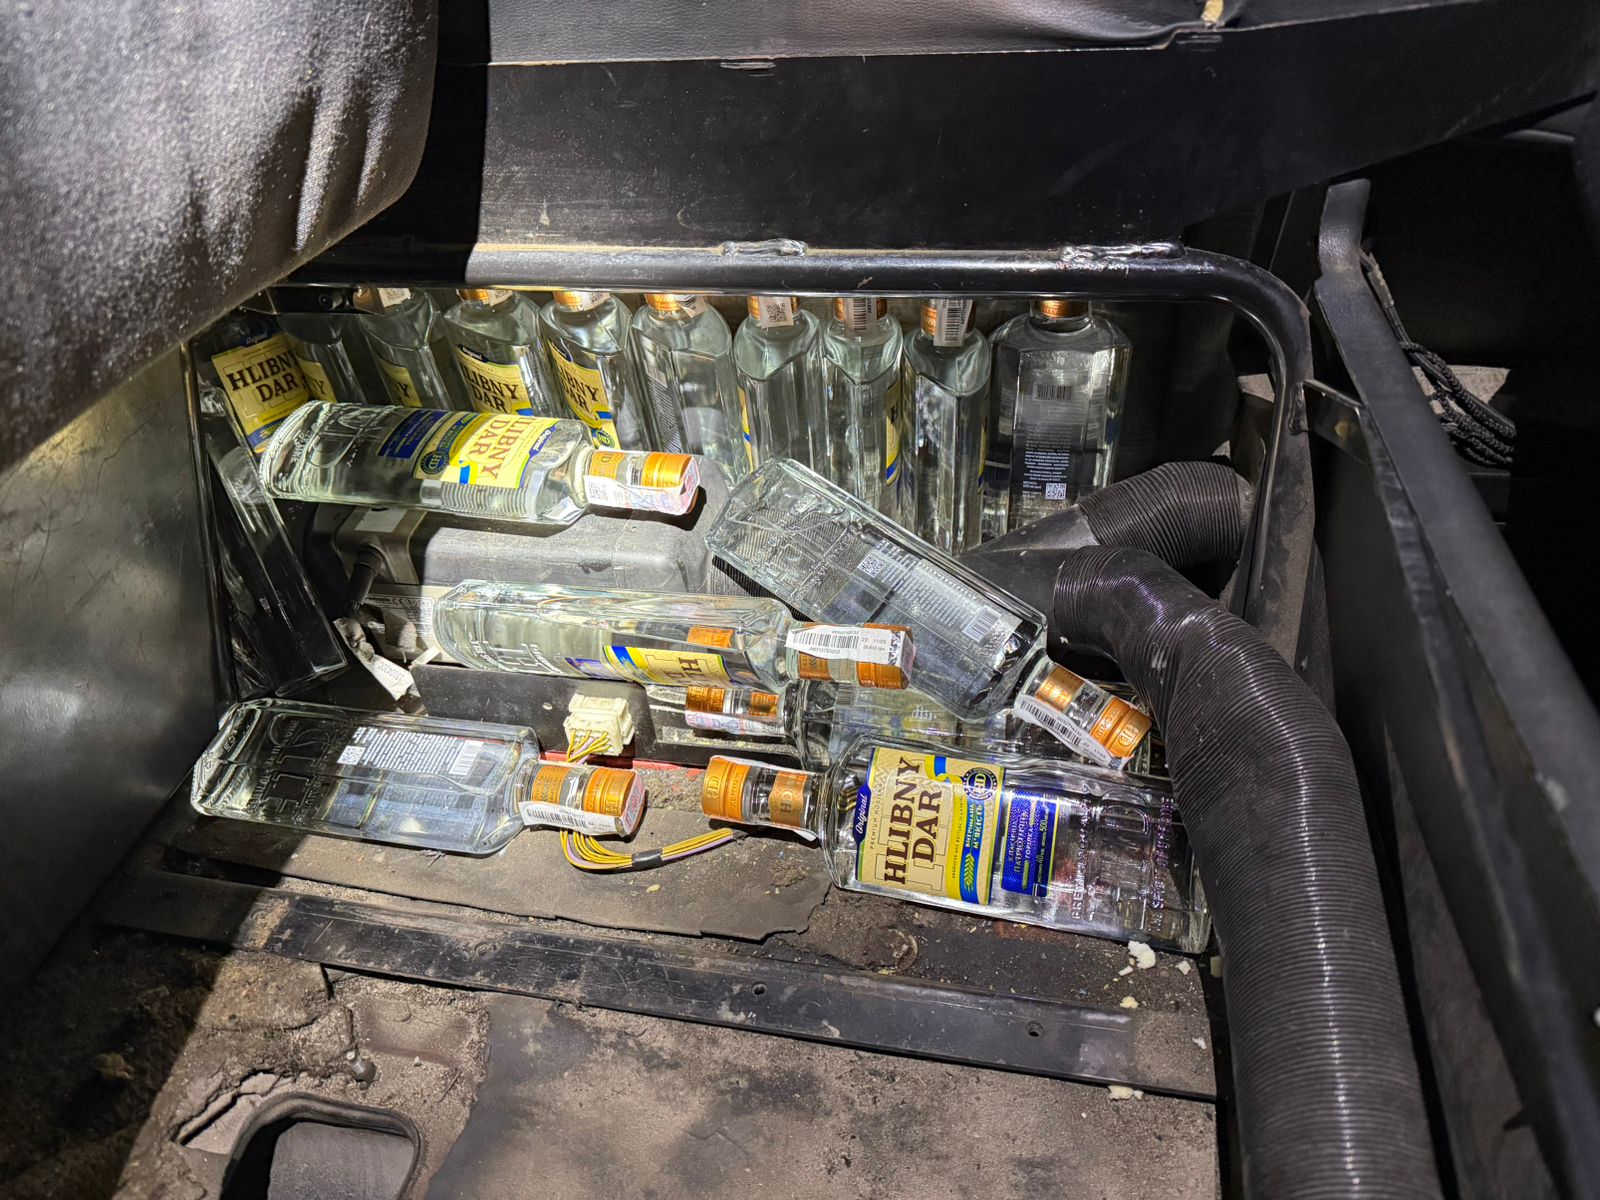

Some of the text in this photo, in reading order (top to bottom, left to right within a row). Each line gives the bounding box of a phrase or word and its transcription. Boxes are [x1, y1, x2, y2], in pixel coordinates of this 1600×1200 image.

[256, 372, 299, 402] DAR
[463, 365, 519, 400] LIBNY
[471, 383, 508, 414] DAR
[468, 419, 504, 455] DAR
[481, 416, 536, 479] LIBNY
[972, 772, 987, 795] HD
[780, 791, 793, 813] HD
[855, 794, 868, 835] Original
[884, 756, 920, 885] HLIBNY
[912, 789, 943, 863] DAR
